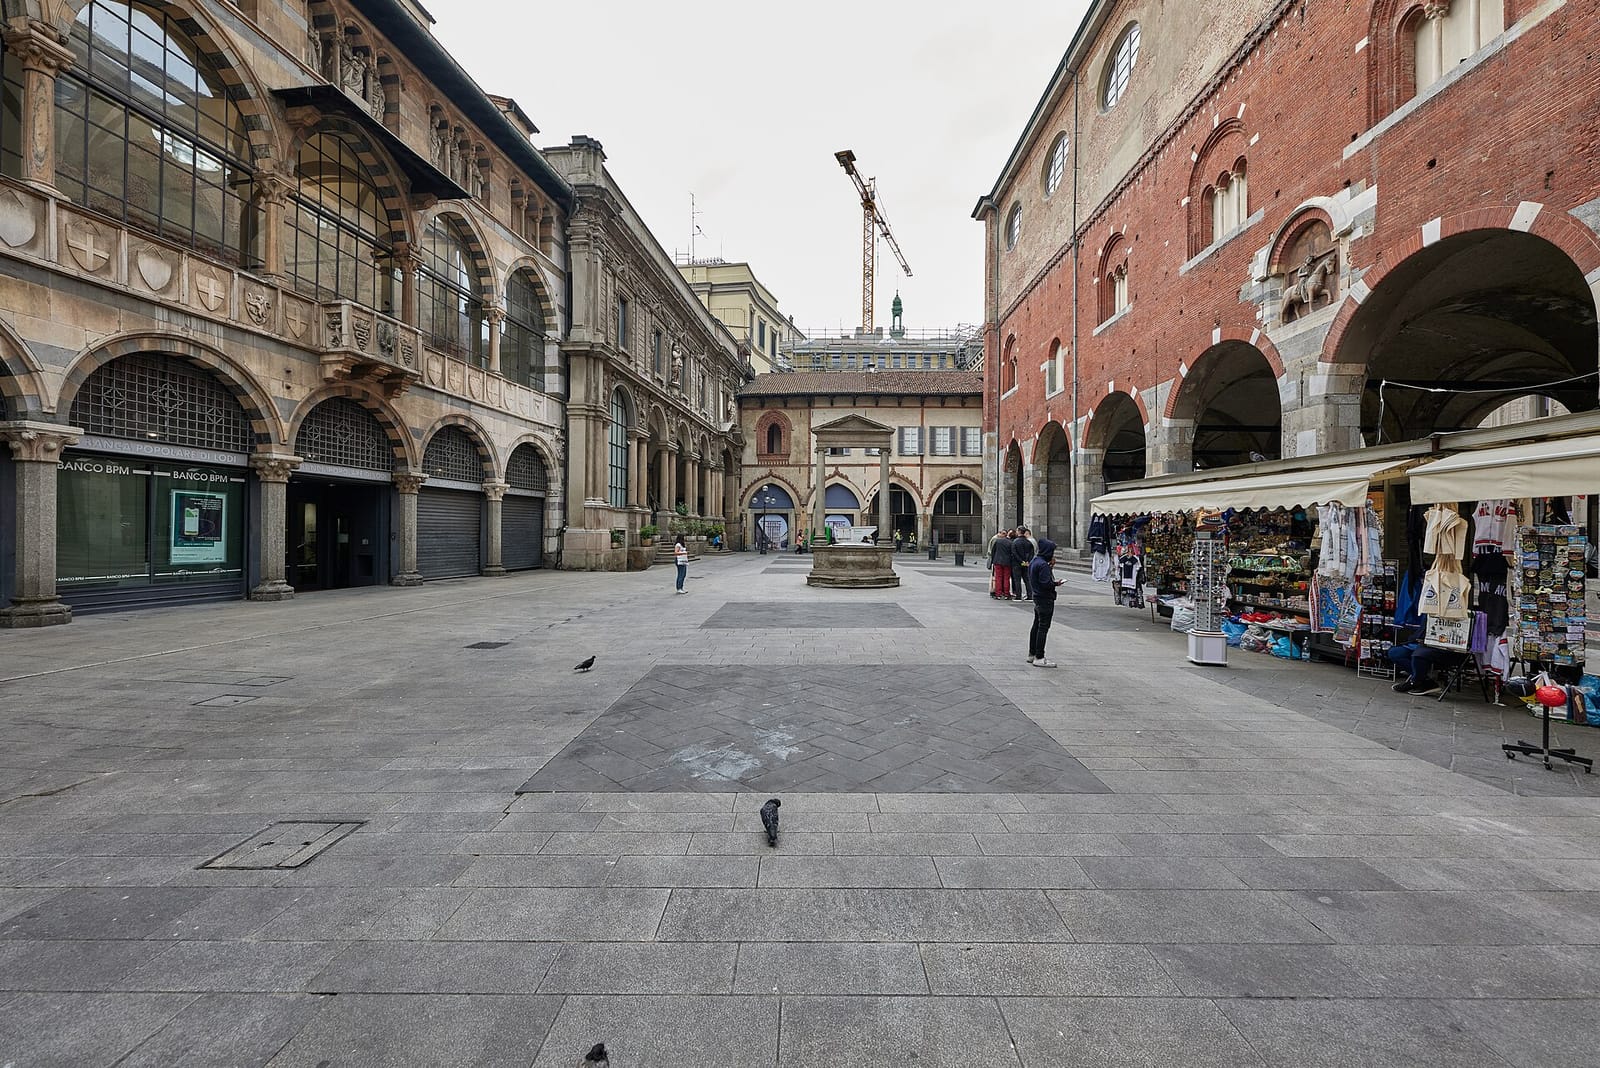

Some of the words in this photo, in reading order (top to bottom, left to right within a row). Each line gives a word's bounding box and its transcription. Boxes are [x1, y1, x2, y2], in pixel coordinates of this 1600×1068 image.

[85, 437, 130, 451] BANCA
[136, 444, 197, 458] POPOLARE
[200, 451, 210, 460] DI
[214, 454, 237, 463] LODI
[57, 461, 103, 473] BANCO
[105, 465, 130, 475] BPM
[173, 471, 208, 482] BANCO
[209, 474, 228, 483] BPM
